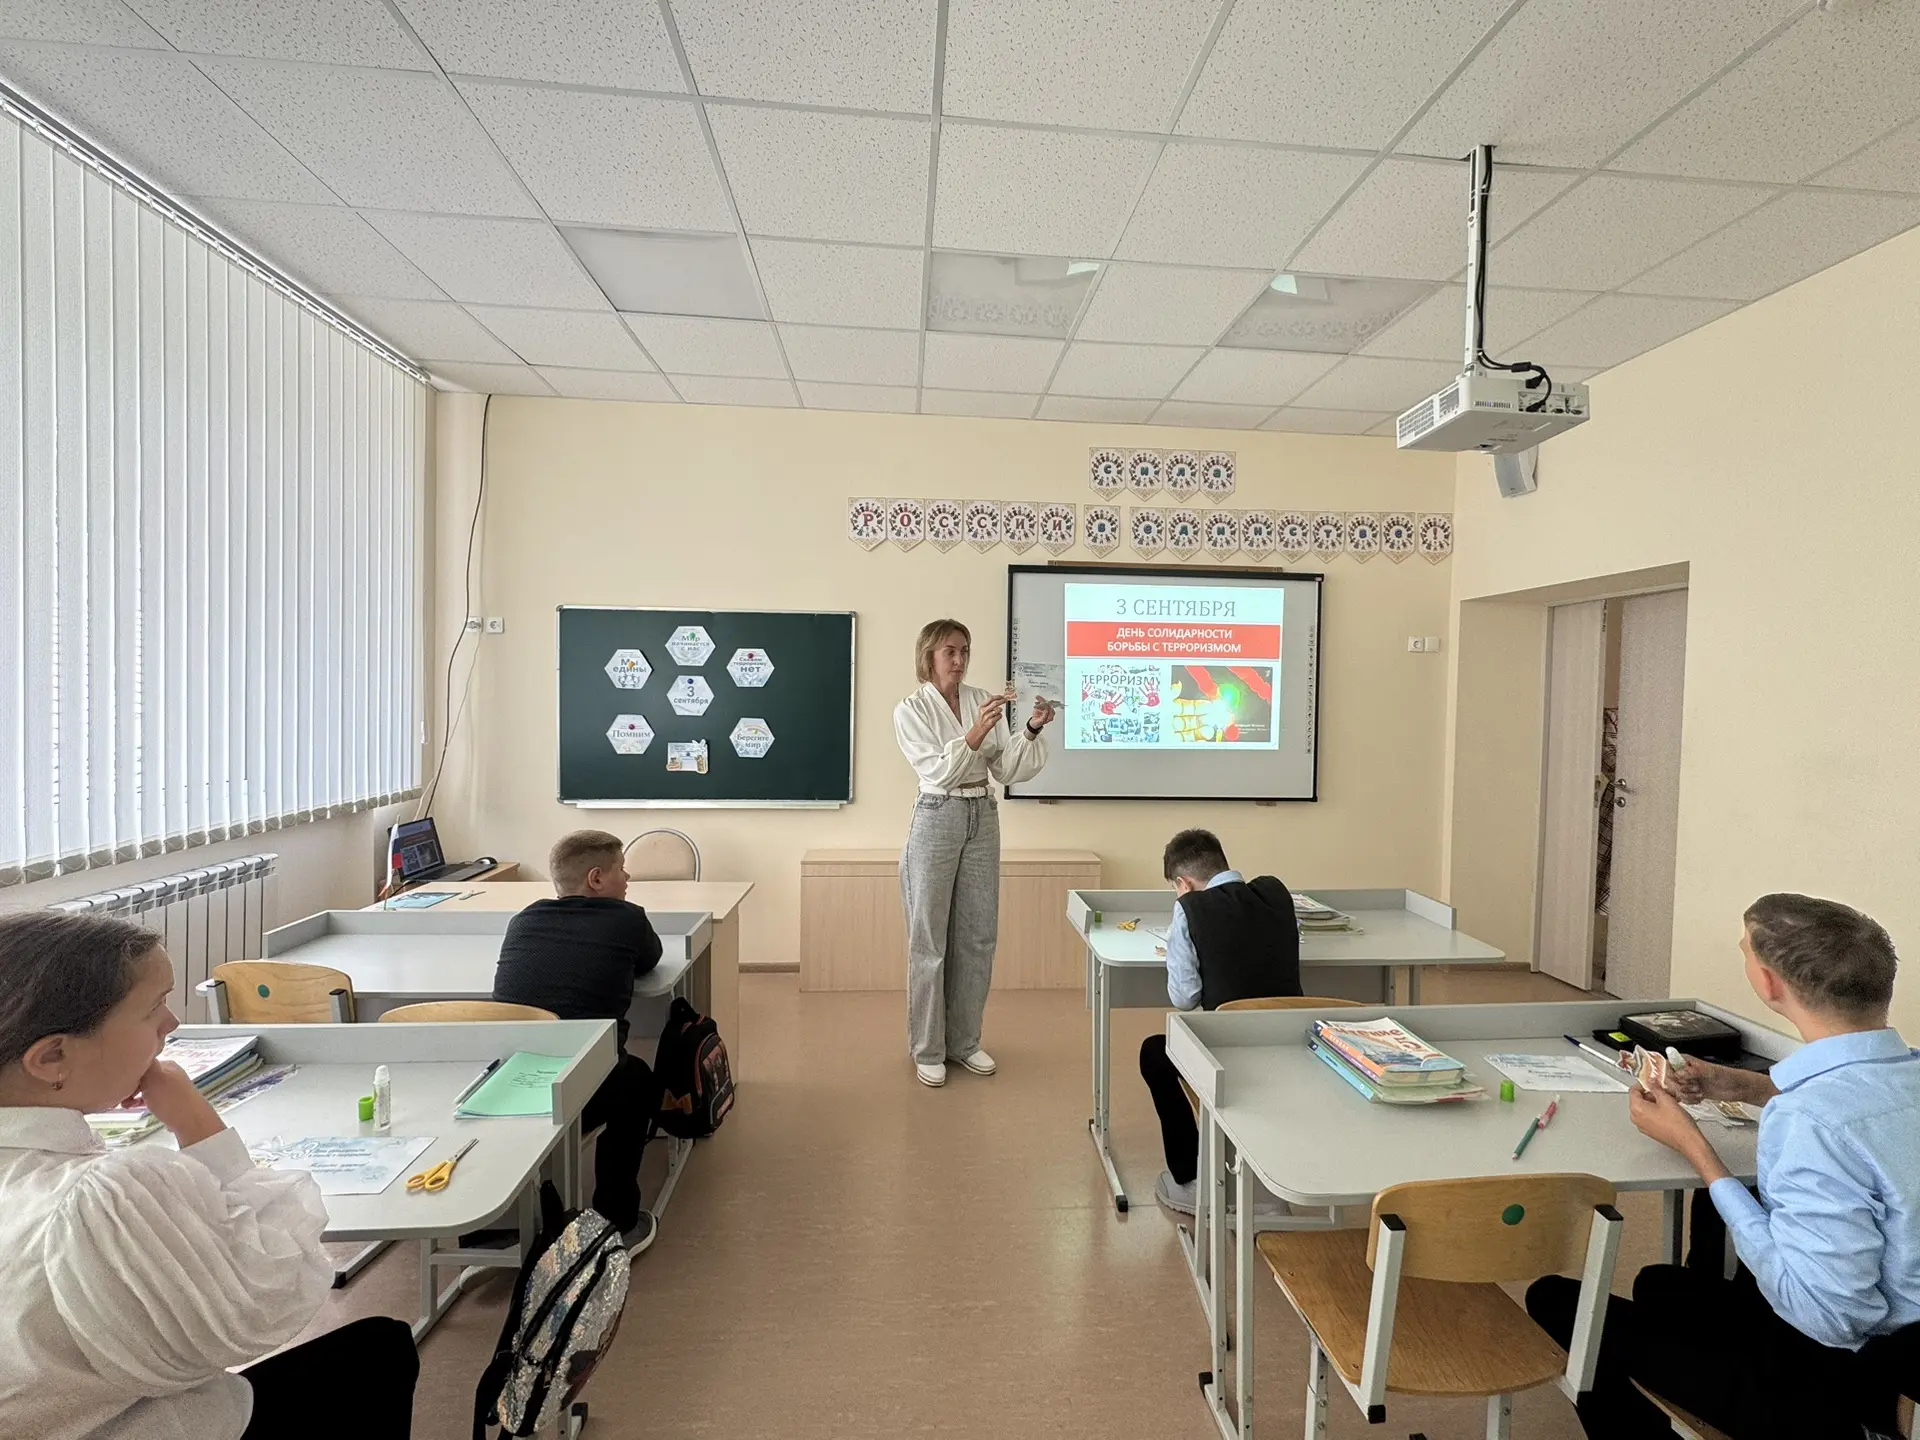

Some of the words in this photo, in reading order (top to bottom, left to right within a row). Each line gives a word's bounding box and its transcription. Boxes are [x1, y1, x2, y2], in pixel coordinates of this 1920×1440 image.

[1116, 598, 1126, 615] 3
[1133, 599, 1236, 617] СЕНТЯБРЯ
[1116, 627, 1145, 639] ДЕНЬ
[1147, 627, 1232, 640] СОЛИДАРНОСТИ
[1107, 641, 1151, 652] БОРЬБЫ
[1152, 642, 1159, 652] С
[1162, 642, 1241, 653] ТЕРРОРИЗМОМ
[612, 666, 647, 674] едины
[686, 686, 695, 698] 3
[673, 697, 709, 705] сентября
[612, 729, 651, 739] Помним
